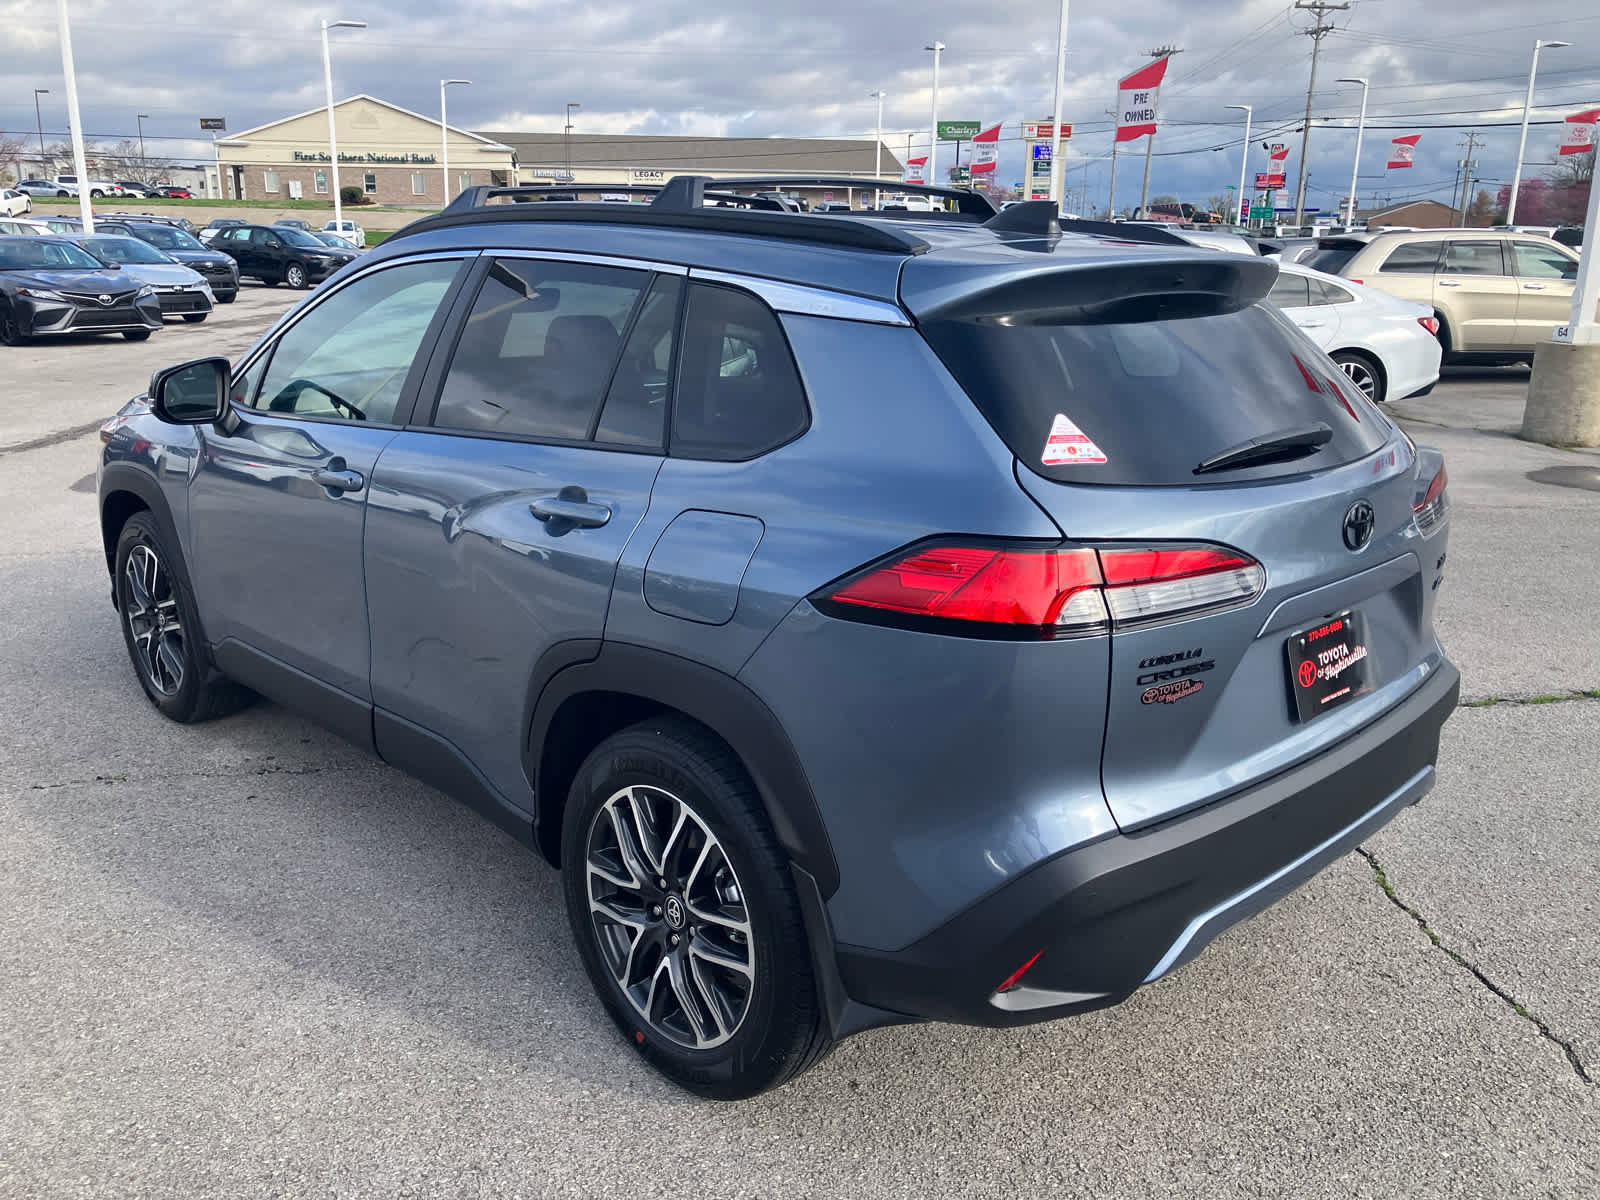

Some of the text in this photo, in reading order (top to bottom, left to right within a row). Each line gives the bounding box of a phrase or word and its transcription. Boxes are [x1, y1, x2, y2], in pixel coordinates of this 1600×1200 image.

[1133, 92, 1149, 105] PRE
[1124, 108, 1155, 122] OWNED
[946, 126, 979, 136] Charleys
[294, 151, 437, 163] First Sothern National Bank
[1558, 327, 1568, 337] 64
[1138, 648, 1203, 669] COROLLA
[1318, 642, 1349, 666] TOYOTA
[1136, 659, 1216, 686] CROSS
[1158, 680, 1191, 695] TOYOTA
